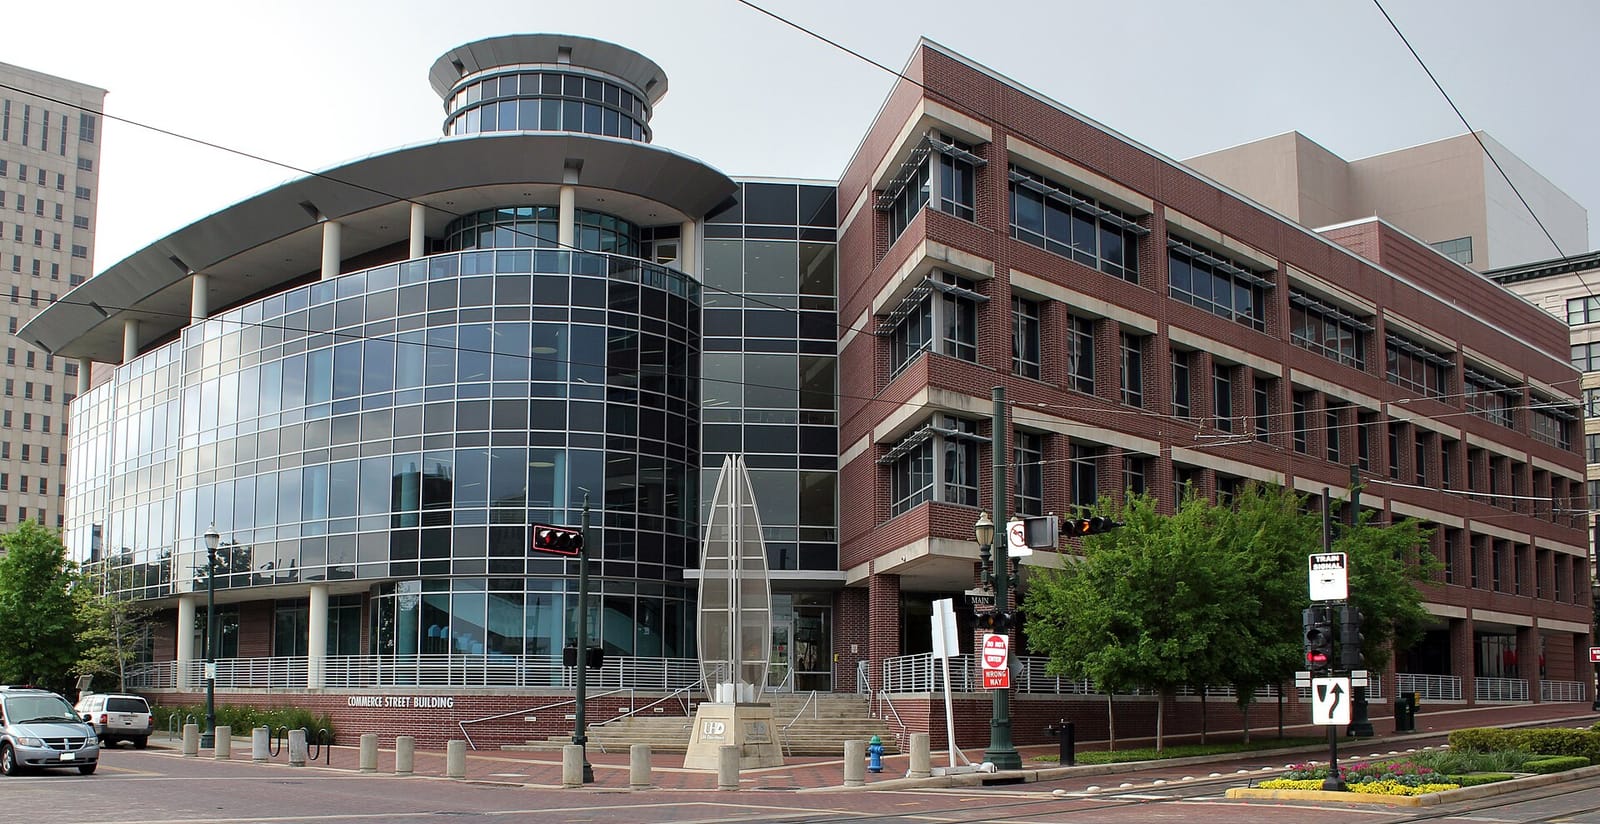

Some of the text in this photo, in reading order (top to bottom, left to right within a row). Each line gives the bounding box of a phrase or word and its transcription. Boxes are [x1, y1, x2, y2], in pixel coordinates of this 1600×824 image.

[971, 596, 989, 604] MAIN
[347, 696, 454, 708] COMMERCE STREET BUILDING
